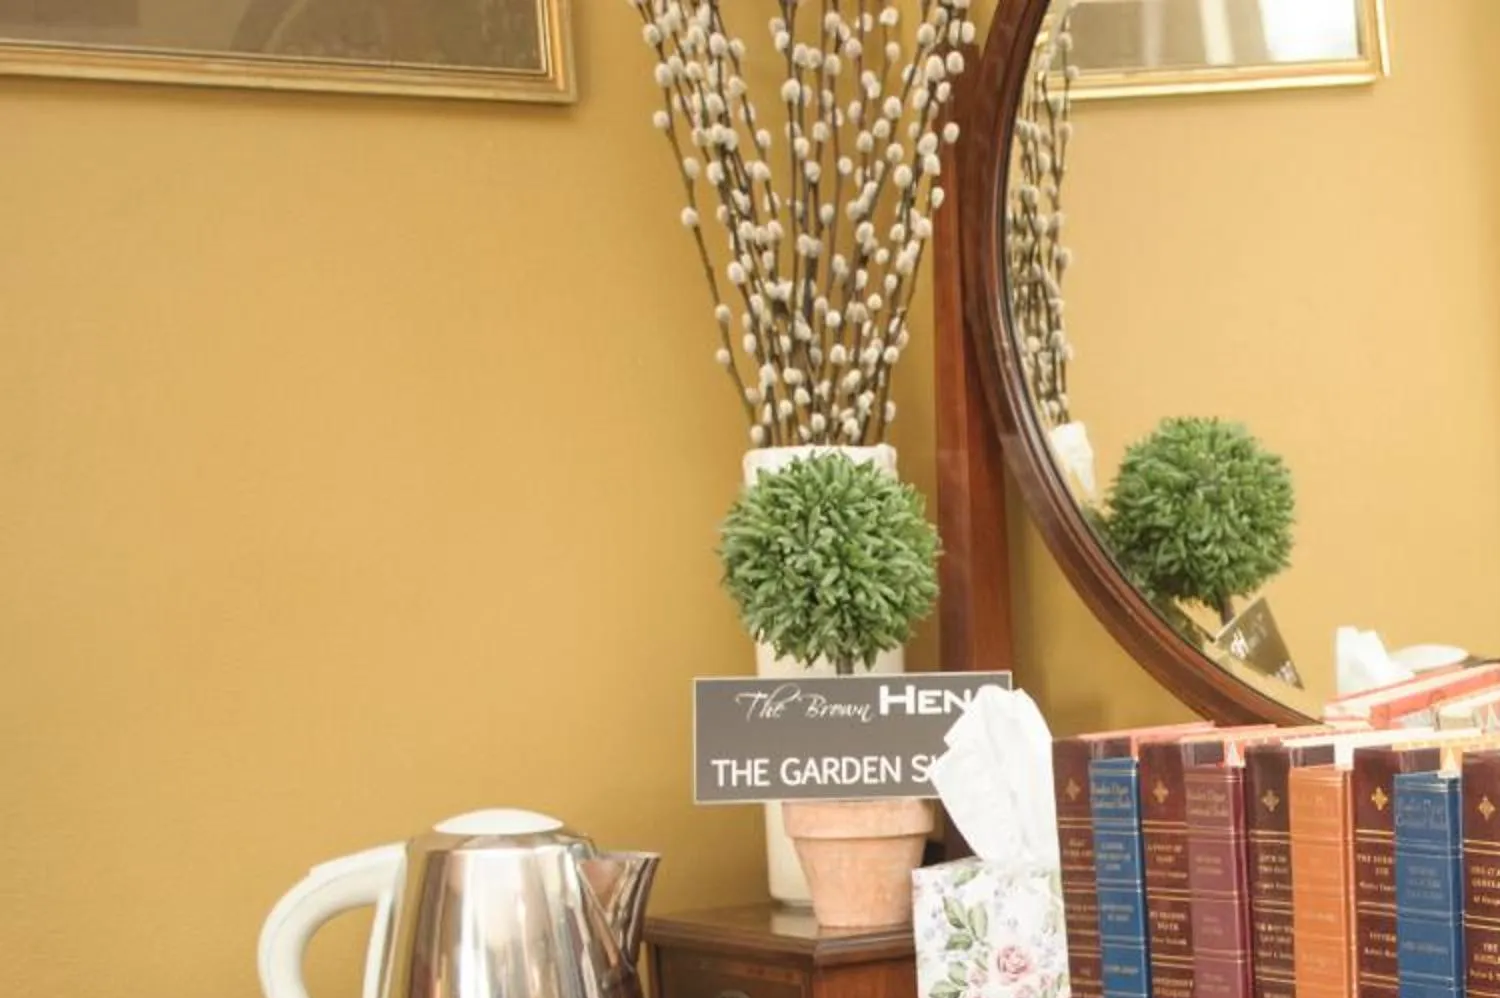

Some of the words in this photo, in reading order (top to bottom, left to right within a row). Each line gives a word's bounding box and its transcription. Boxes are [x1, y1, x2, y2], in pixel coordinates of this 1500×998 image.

[735, 682, 800, 720] The
[799, 694, 875, 722] Brown
[712, 758, 771, 787] THE
[780, 756, 903, 785] GARDEN
